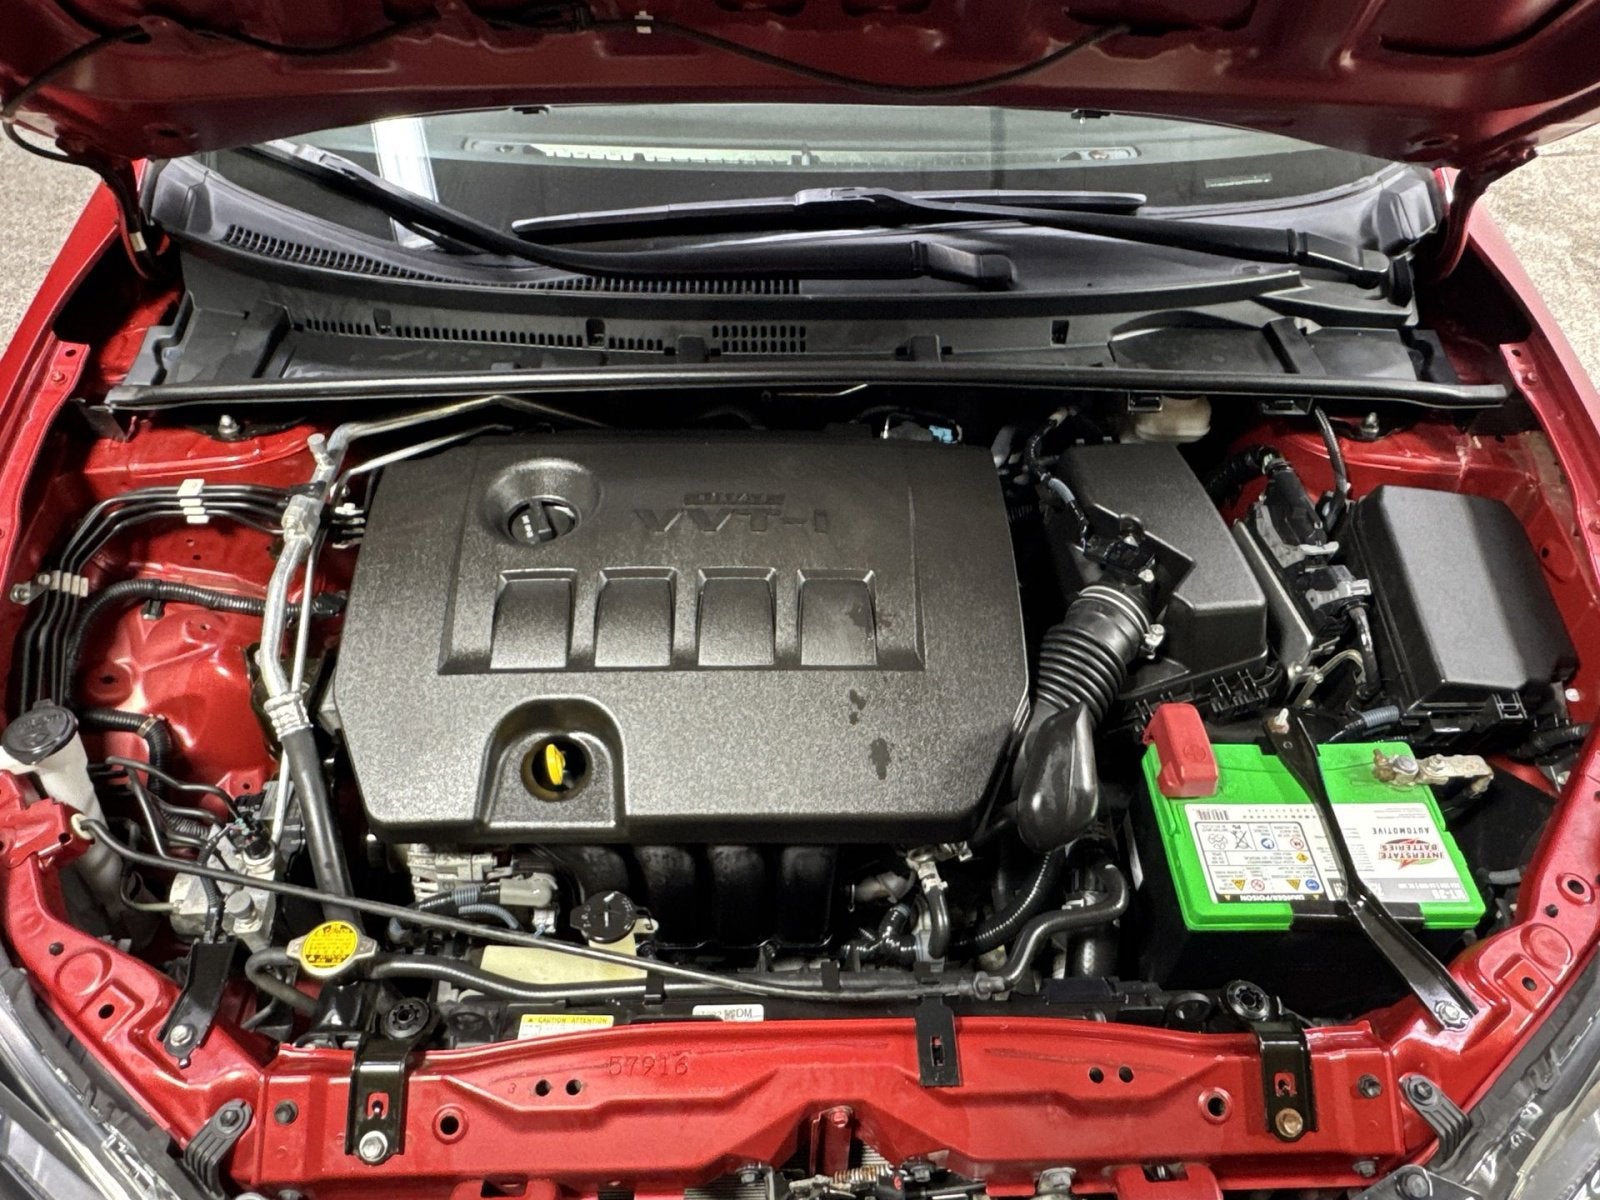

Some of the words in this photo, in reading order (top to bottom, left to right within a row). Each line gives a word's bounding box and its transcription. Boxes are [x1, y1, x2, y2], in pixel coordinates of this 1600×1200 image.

[1372, 827, 1430, 835] AUTOMOTIVE
[1381, 844, 1438, 852] BATTERIES
[1380, 852, 1444, 860] INTERSTATE
[538, 1016, 567, 1024] CAUTION
[571, 1017, 607, 1025] ATTENTION
[608, 1055, 689, 1076] 57916
